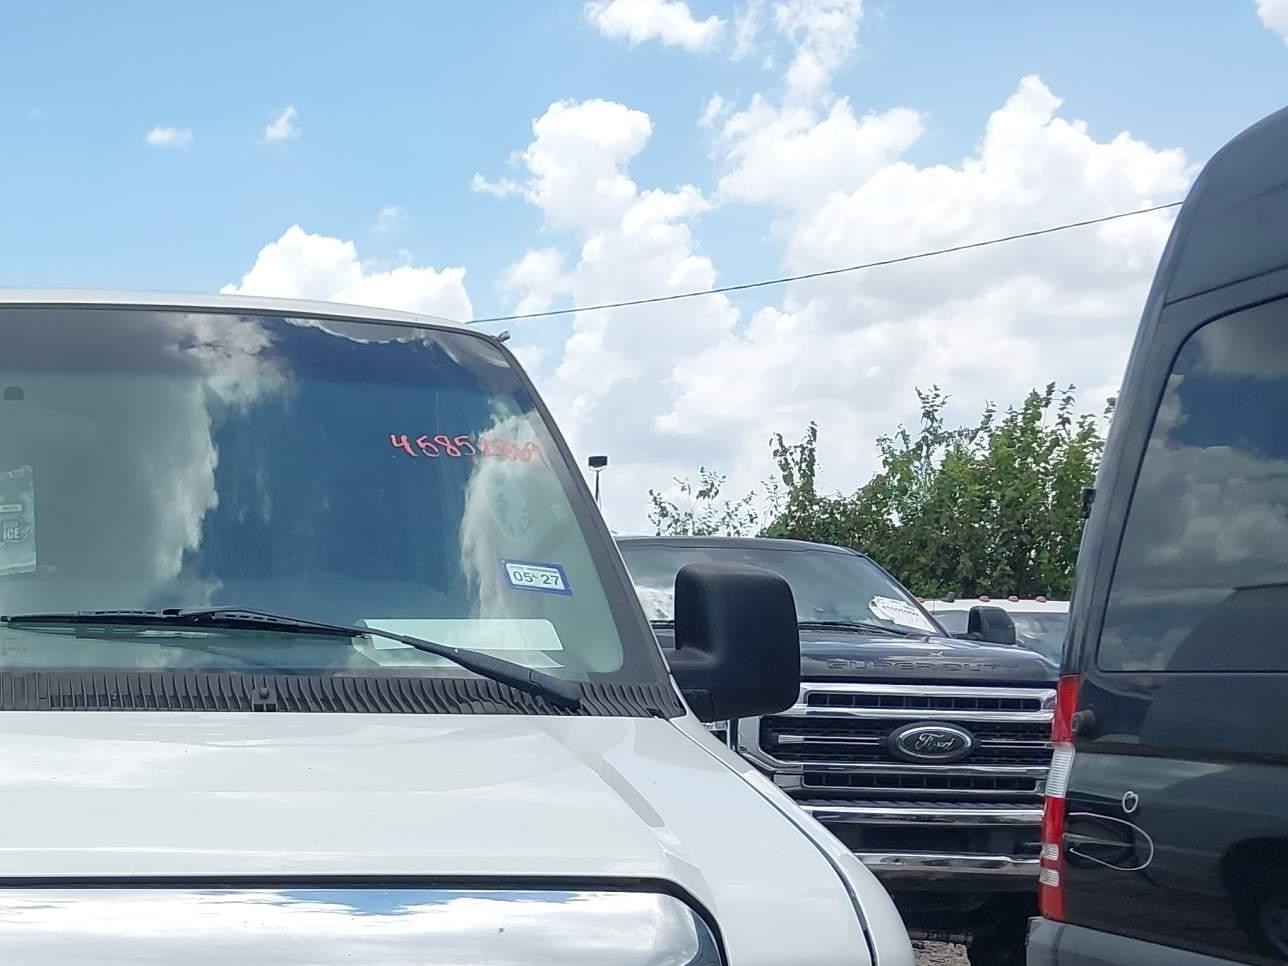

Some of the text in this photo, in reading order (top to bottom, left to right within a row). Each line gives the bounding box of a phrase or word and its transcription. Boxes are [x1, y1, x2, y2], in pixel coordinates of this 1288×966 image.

[3, 527, 20, 540] ICE
[513, 570, 559, 586] 05 27
[914, 732, 955, 751] Ford
